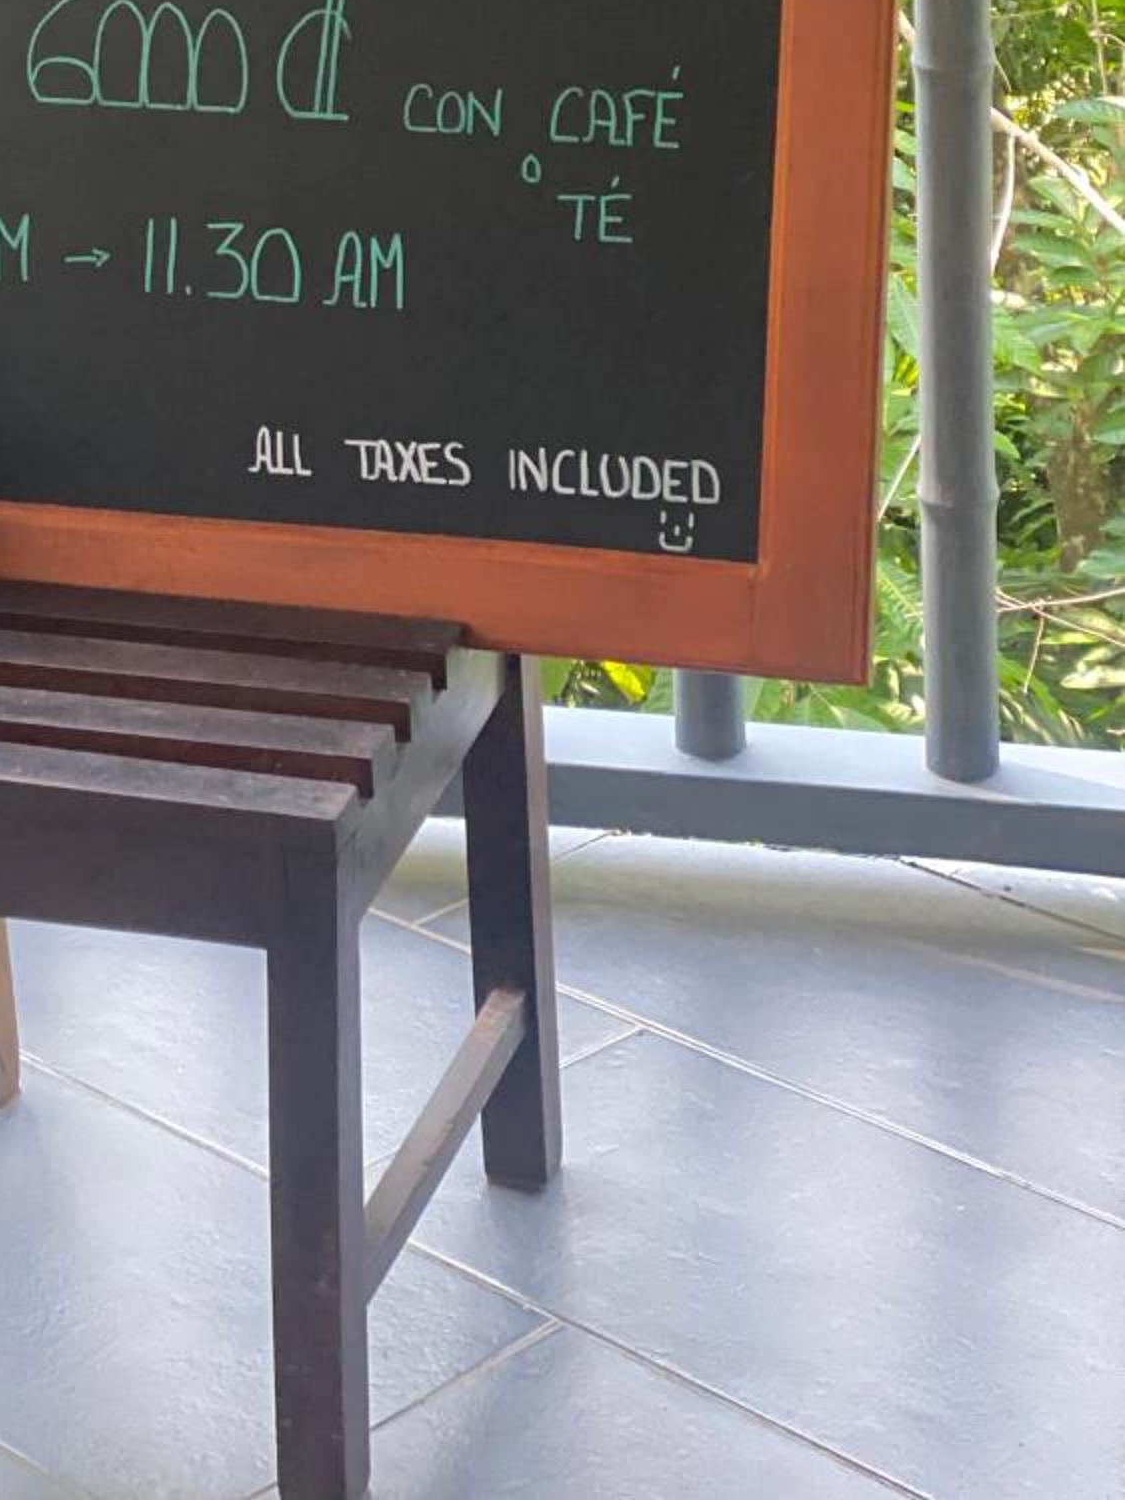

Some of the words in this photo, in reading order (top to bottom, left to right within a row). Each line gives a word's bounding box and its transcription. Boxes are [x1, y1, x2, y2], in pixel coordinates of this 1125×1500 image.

[402, 82, 504, 137] CON
[549, 65, 684, 149] CAFÉ
[556, 174, 634, 244] TÉ
[321, 231, 404, 311] AM
[246, 424, 314, 477] ALL
[343, 438, 472, 487] TAXES
[508, 446, 721, 505] INCLUDED
